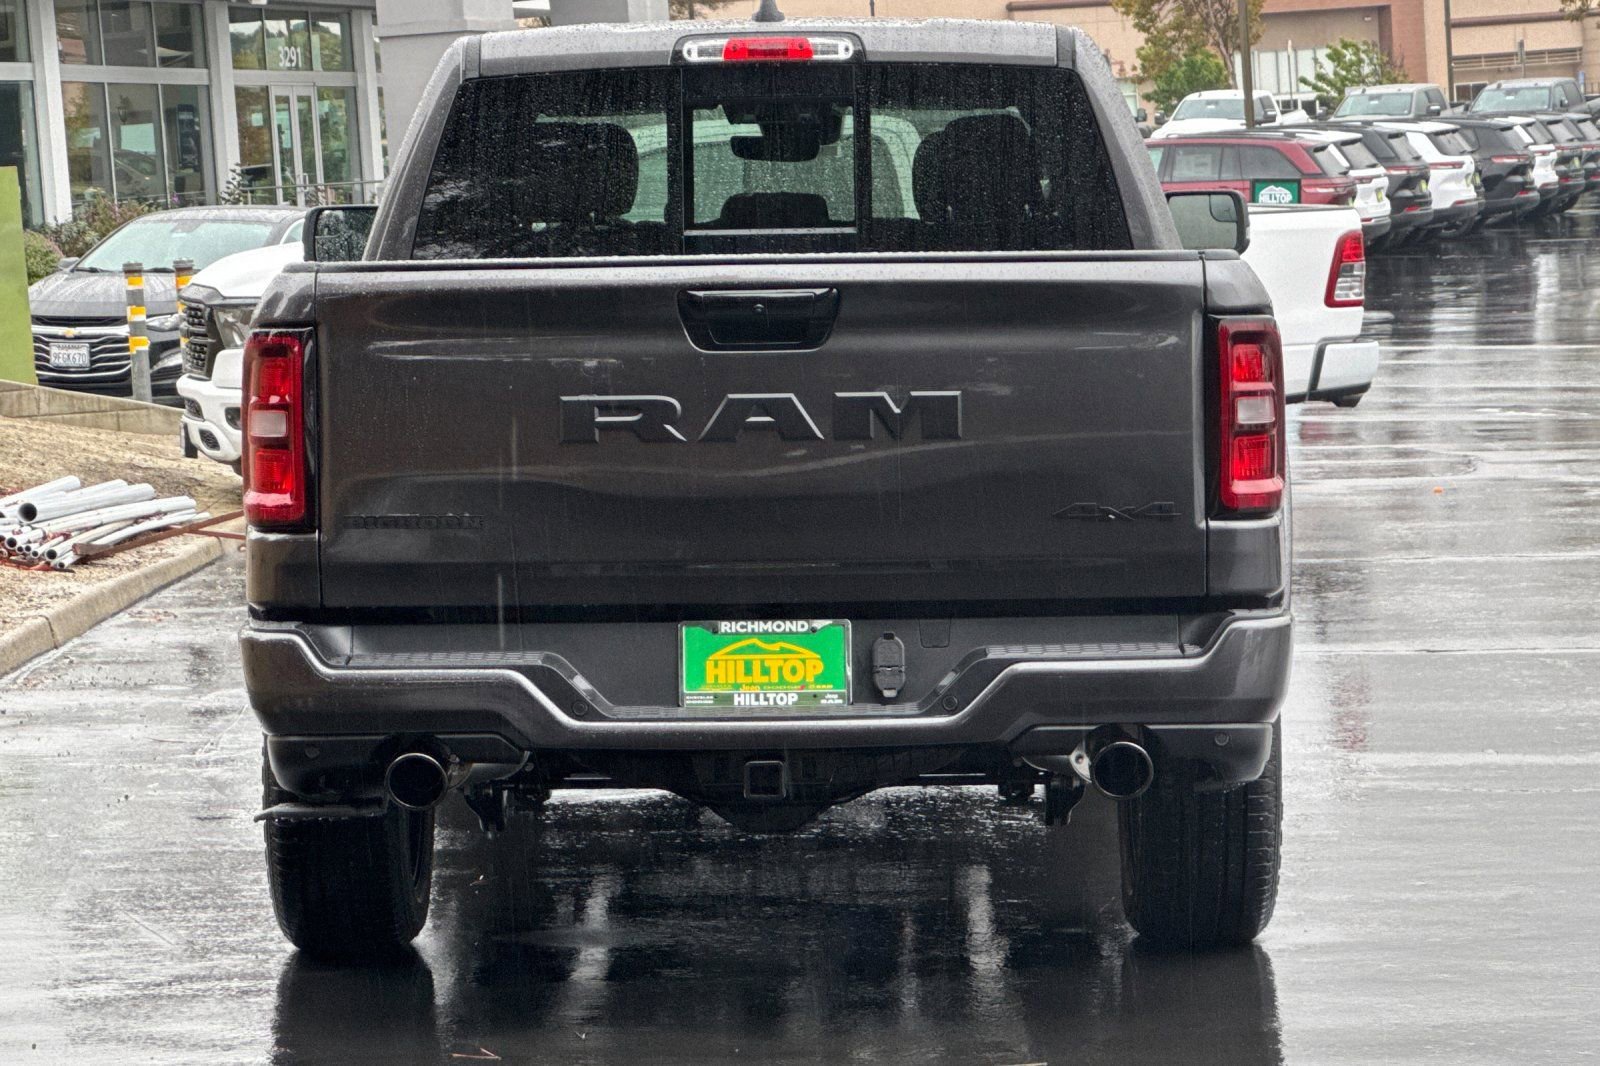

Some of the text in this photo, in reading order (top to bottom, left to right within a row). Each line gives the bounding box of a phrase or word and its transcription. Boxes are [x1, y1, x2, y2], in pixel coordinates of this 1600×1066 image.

[278, 46, 302, 68] 3291
[559, 391, 962, 443] RAM
[720, 620, 809, 633] RICHMOND
[705, 658, 824, 684] HILLTOP
[733, 693, 799, 706] HILLTOP
